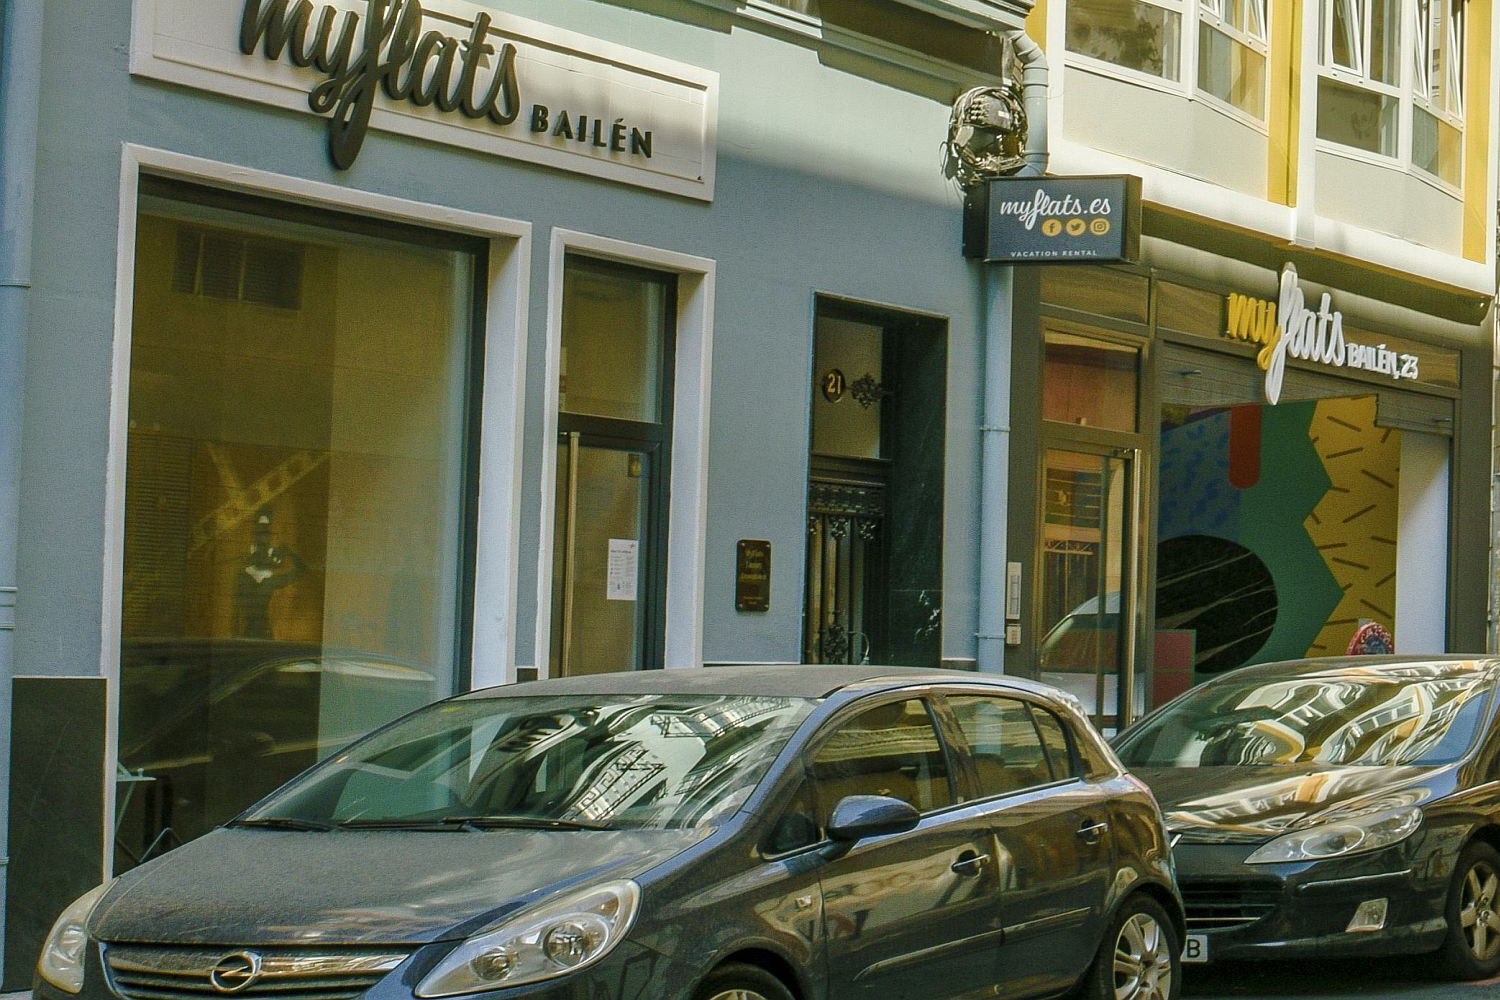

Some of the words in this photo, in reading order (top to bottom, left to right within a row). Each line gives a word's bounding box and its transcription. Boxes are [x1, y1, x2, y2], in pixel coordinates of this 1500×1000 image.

[531, 104, 652, 159] BAILÉN
[1000, 189, 1111, 230] myflats.es
[1010, 250, 1058, 258] VACATION
[1227, 261, 1346, 405] myflats
[1399, 353, 1419, 380] 23
[827, 373, 841, 395] 21
